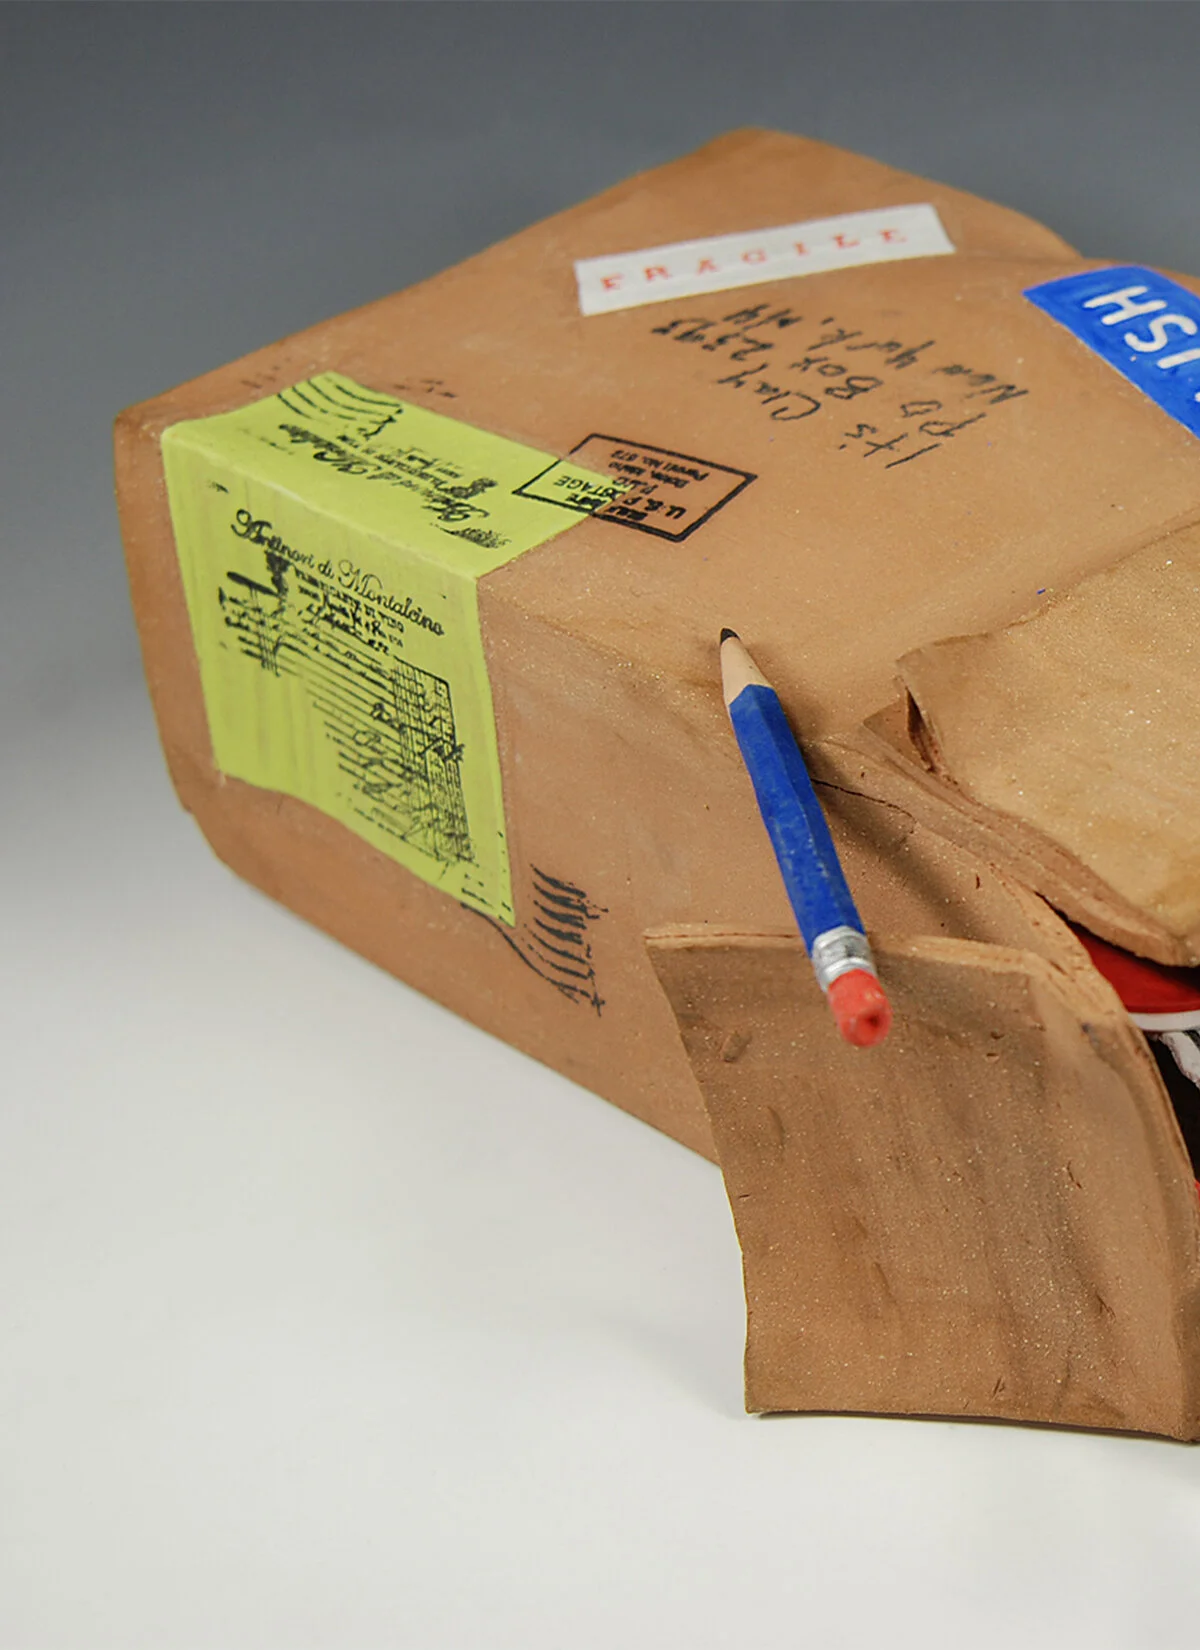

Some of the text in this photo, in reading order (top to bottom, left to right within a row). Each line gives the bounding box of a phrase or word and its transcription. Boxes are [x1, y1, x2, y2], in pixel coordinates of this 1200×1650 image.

[602, 226, 908, 291] FRAGILE
[718, 363, 821, 420] Clay
[791, 357, 882, 400] Box
